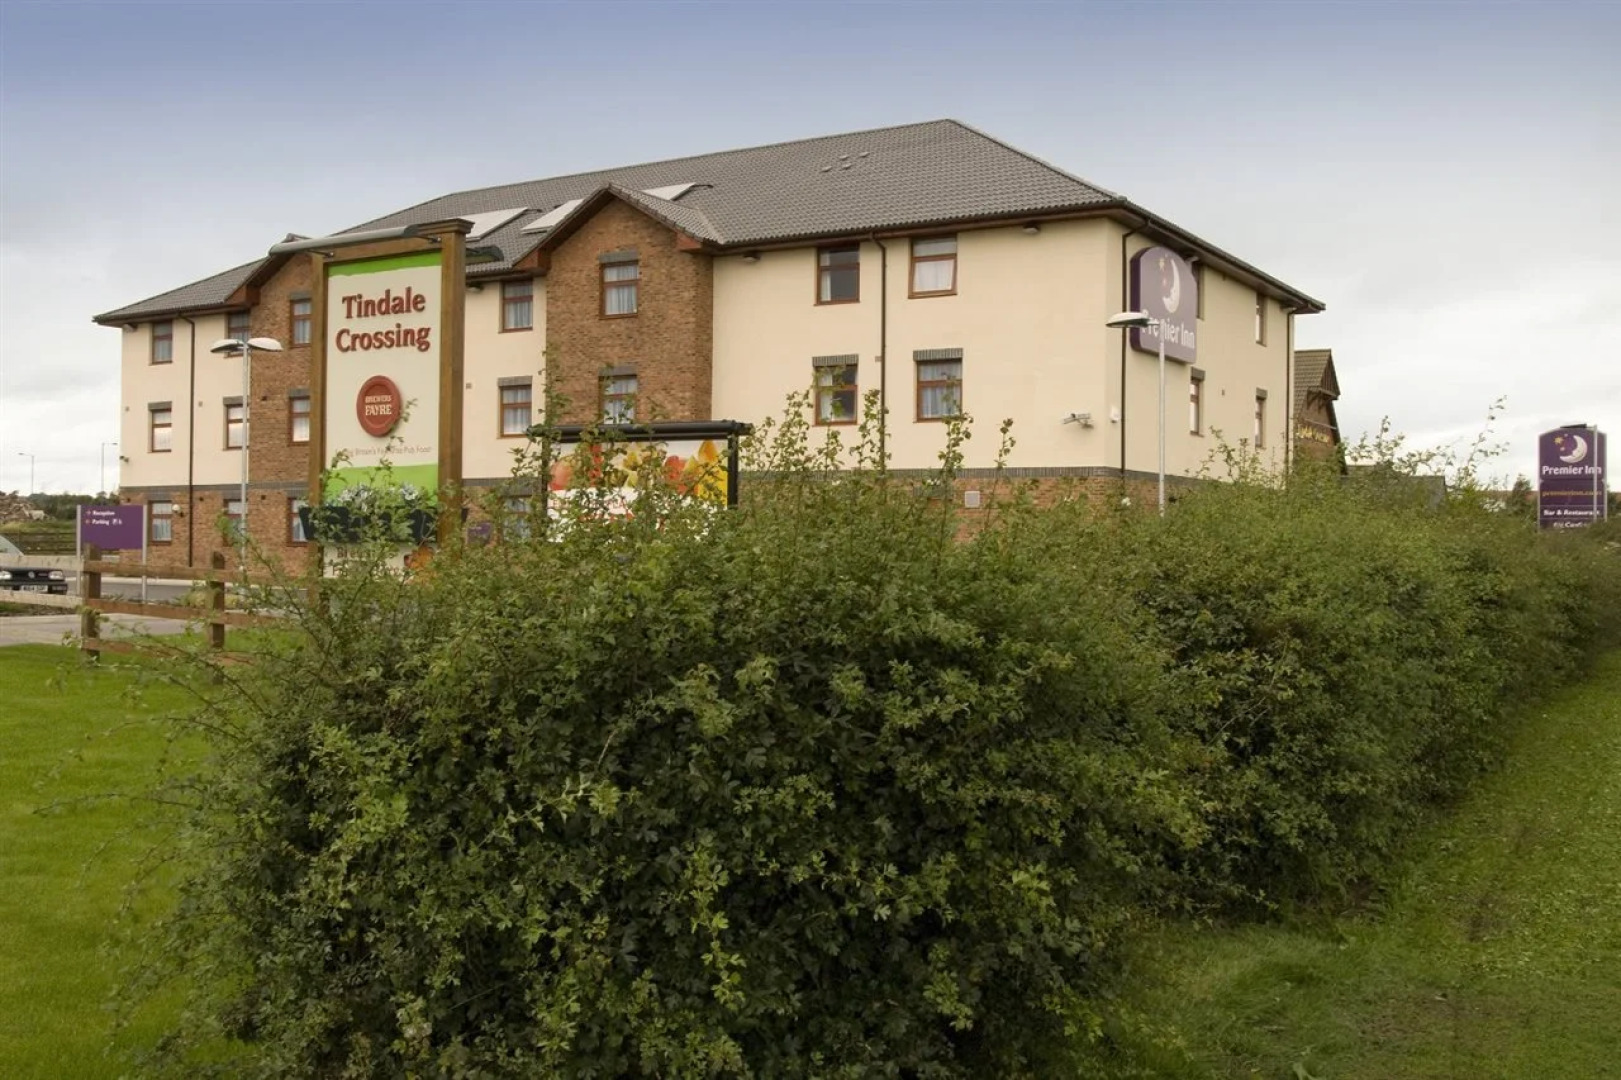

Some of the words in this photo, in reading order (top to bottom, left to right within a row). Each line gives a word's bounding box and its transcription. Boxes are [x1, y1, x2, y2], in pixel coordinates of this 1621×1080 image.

[341, 286, 426, 319] Tindale
[335, 322, 431, 353] Crossing
[1180, 322, 1195, 350] Inn
[365, 404, 392, 416] FAYRE
[1542, 465, 1583, 475] Premier
